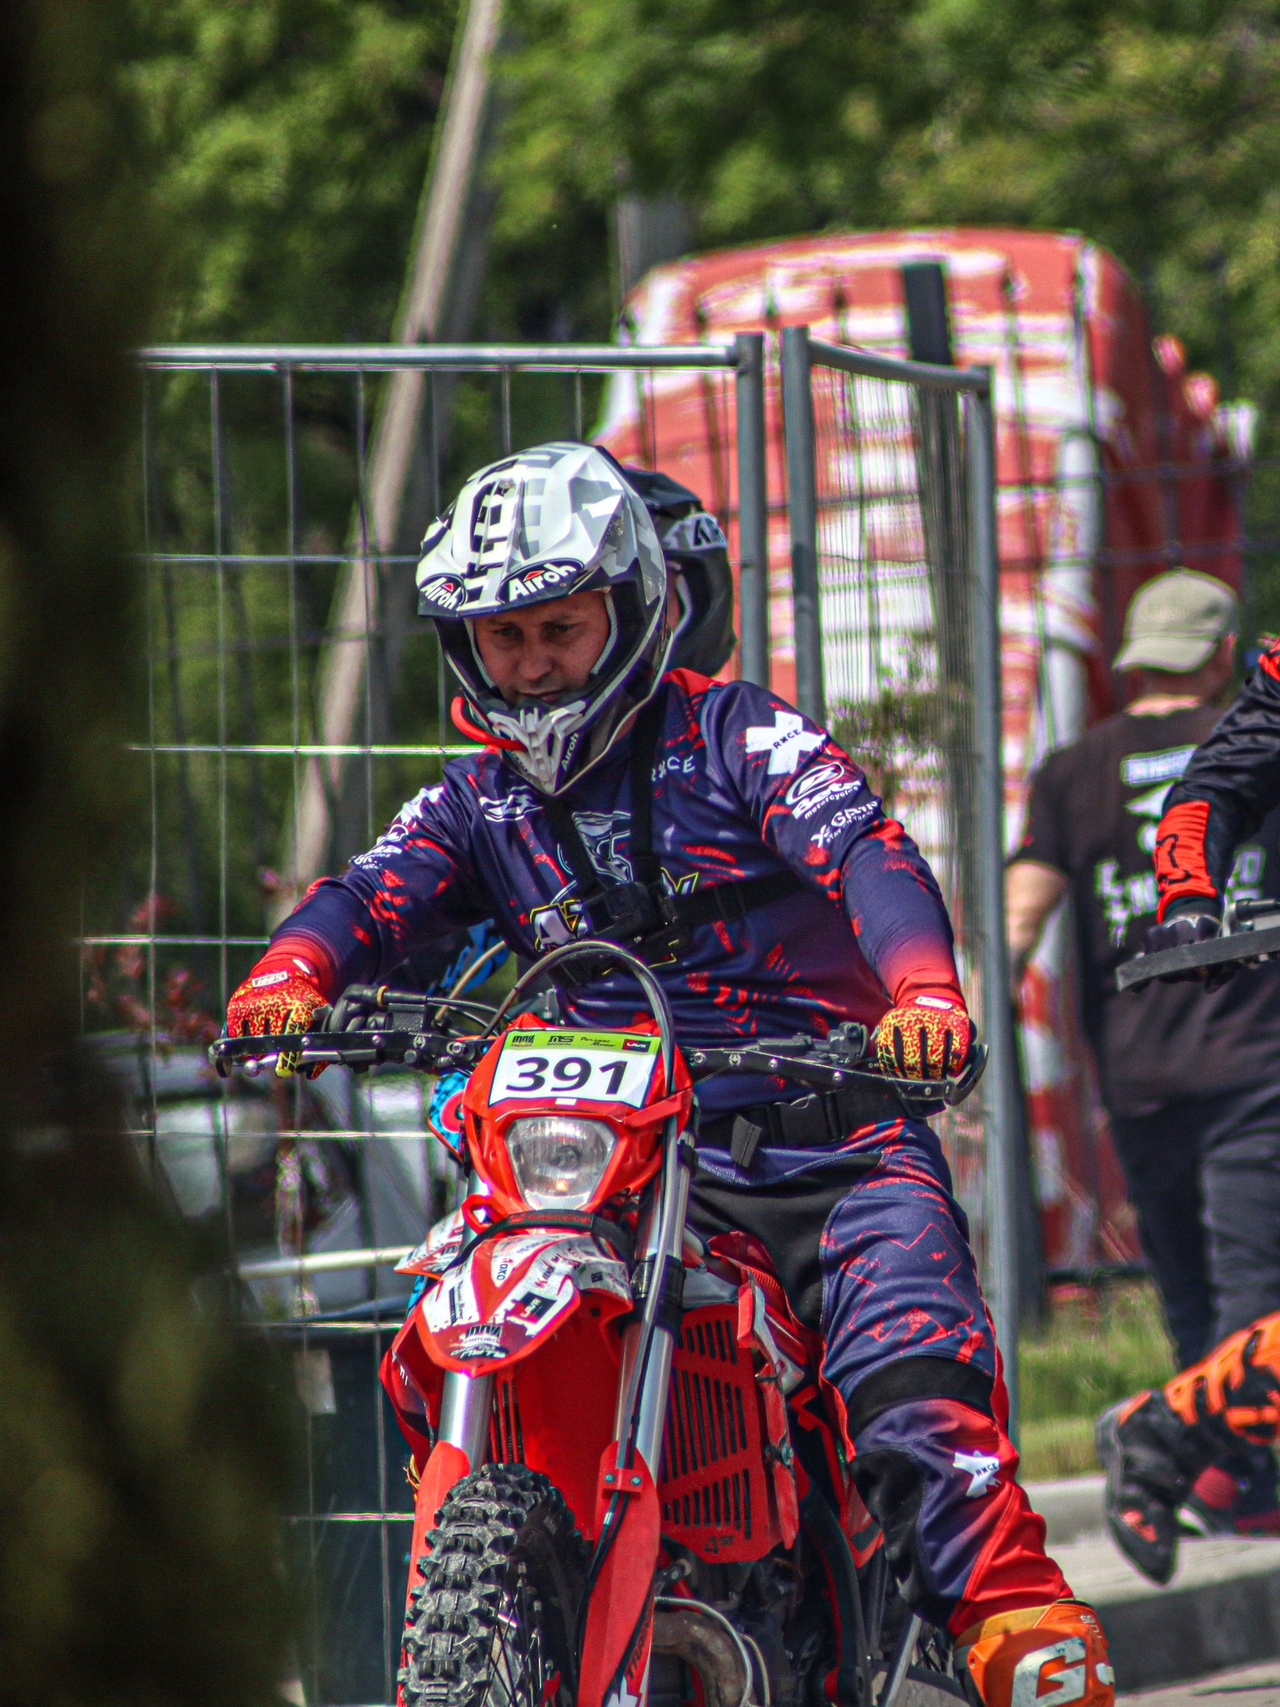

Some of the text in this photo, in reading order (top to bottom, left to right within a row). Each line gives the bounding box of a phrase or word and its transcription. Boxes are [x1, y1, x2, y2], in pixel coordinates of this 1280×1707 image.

[420, 577, 458, 609] Airoh
[508, 563, 578, 602] Airoh
[505, 1055, 629, 1096] 391
